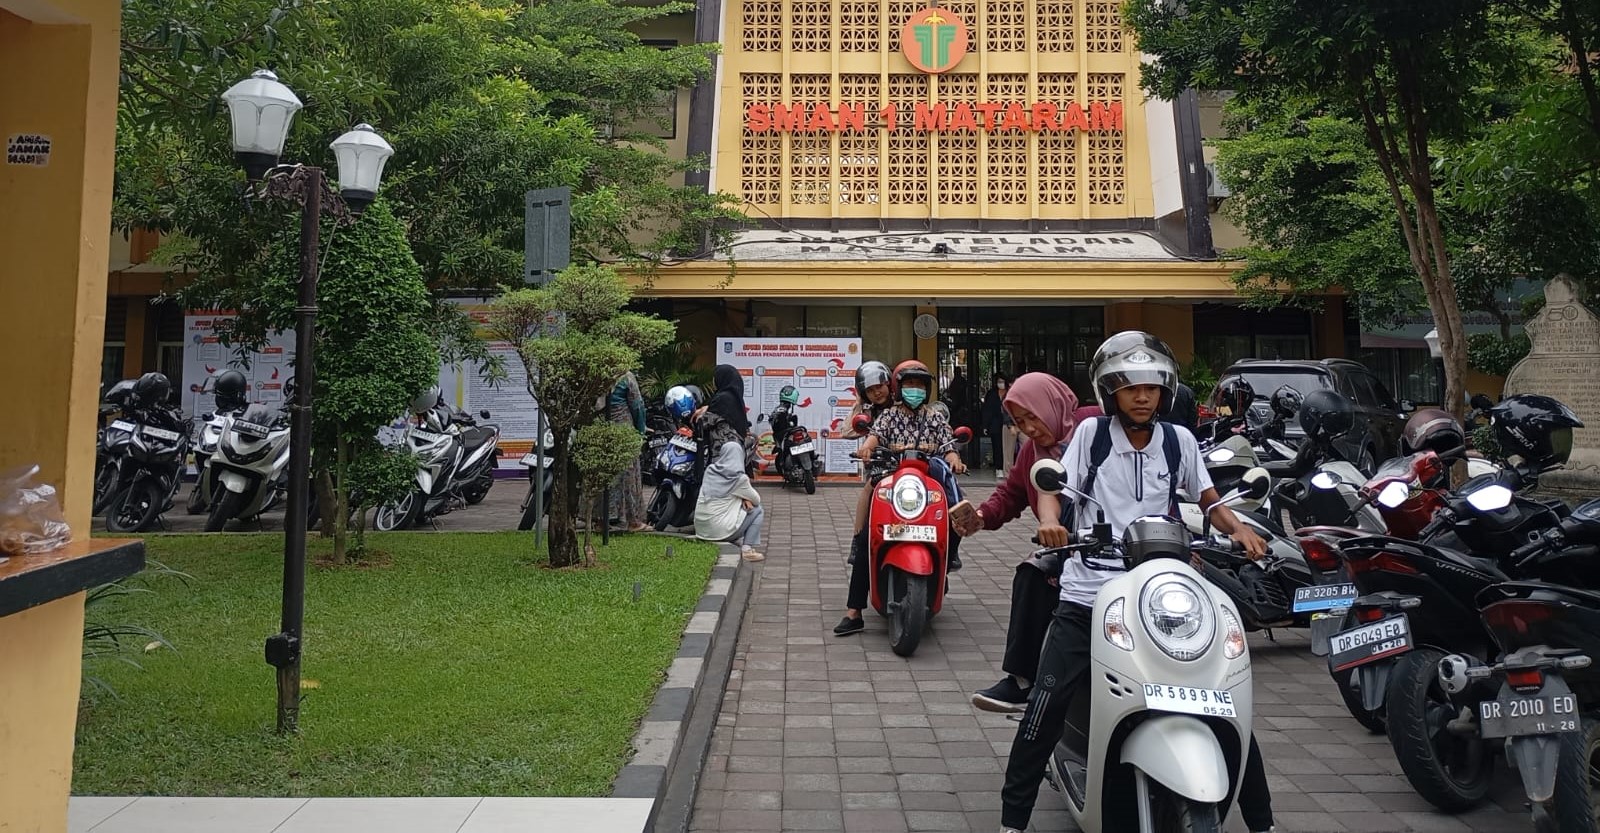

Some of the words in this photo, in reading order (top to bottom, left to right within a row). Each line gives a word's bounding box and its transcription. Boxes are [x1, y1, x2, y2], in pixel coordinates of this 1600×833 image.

[749, 102, 865, 132] SMAN
[879, 102, 897, 132] 1
[914, 101, 1124, 132] MATARAM
[944, 236, 1135, 245] TELADAN
[1436, 562, 1480, 578] VARIO
[1298, 589, 1311, 600] DR
[1314, 586, 1339, 598] 3205
[1341, 585, 1356, 595] BW
[1338, 637, 1353, 651] DR
[1354, 628, 1382, 646] 6049
[1144, 684, 1163, 698] DR
[1167, 686, 1208, 702] 5899
[1213, 690, 1232, 705] NE
[1482, 702, 1501, 719] DR
[1510, 699, 1544, 717] 2010
[1553, 696, 1573, 714] ED
